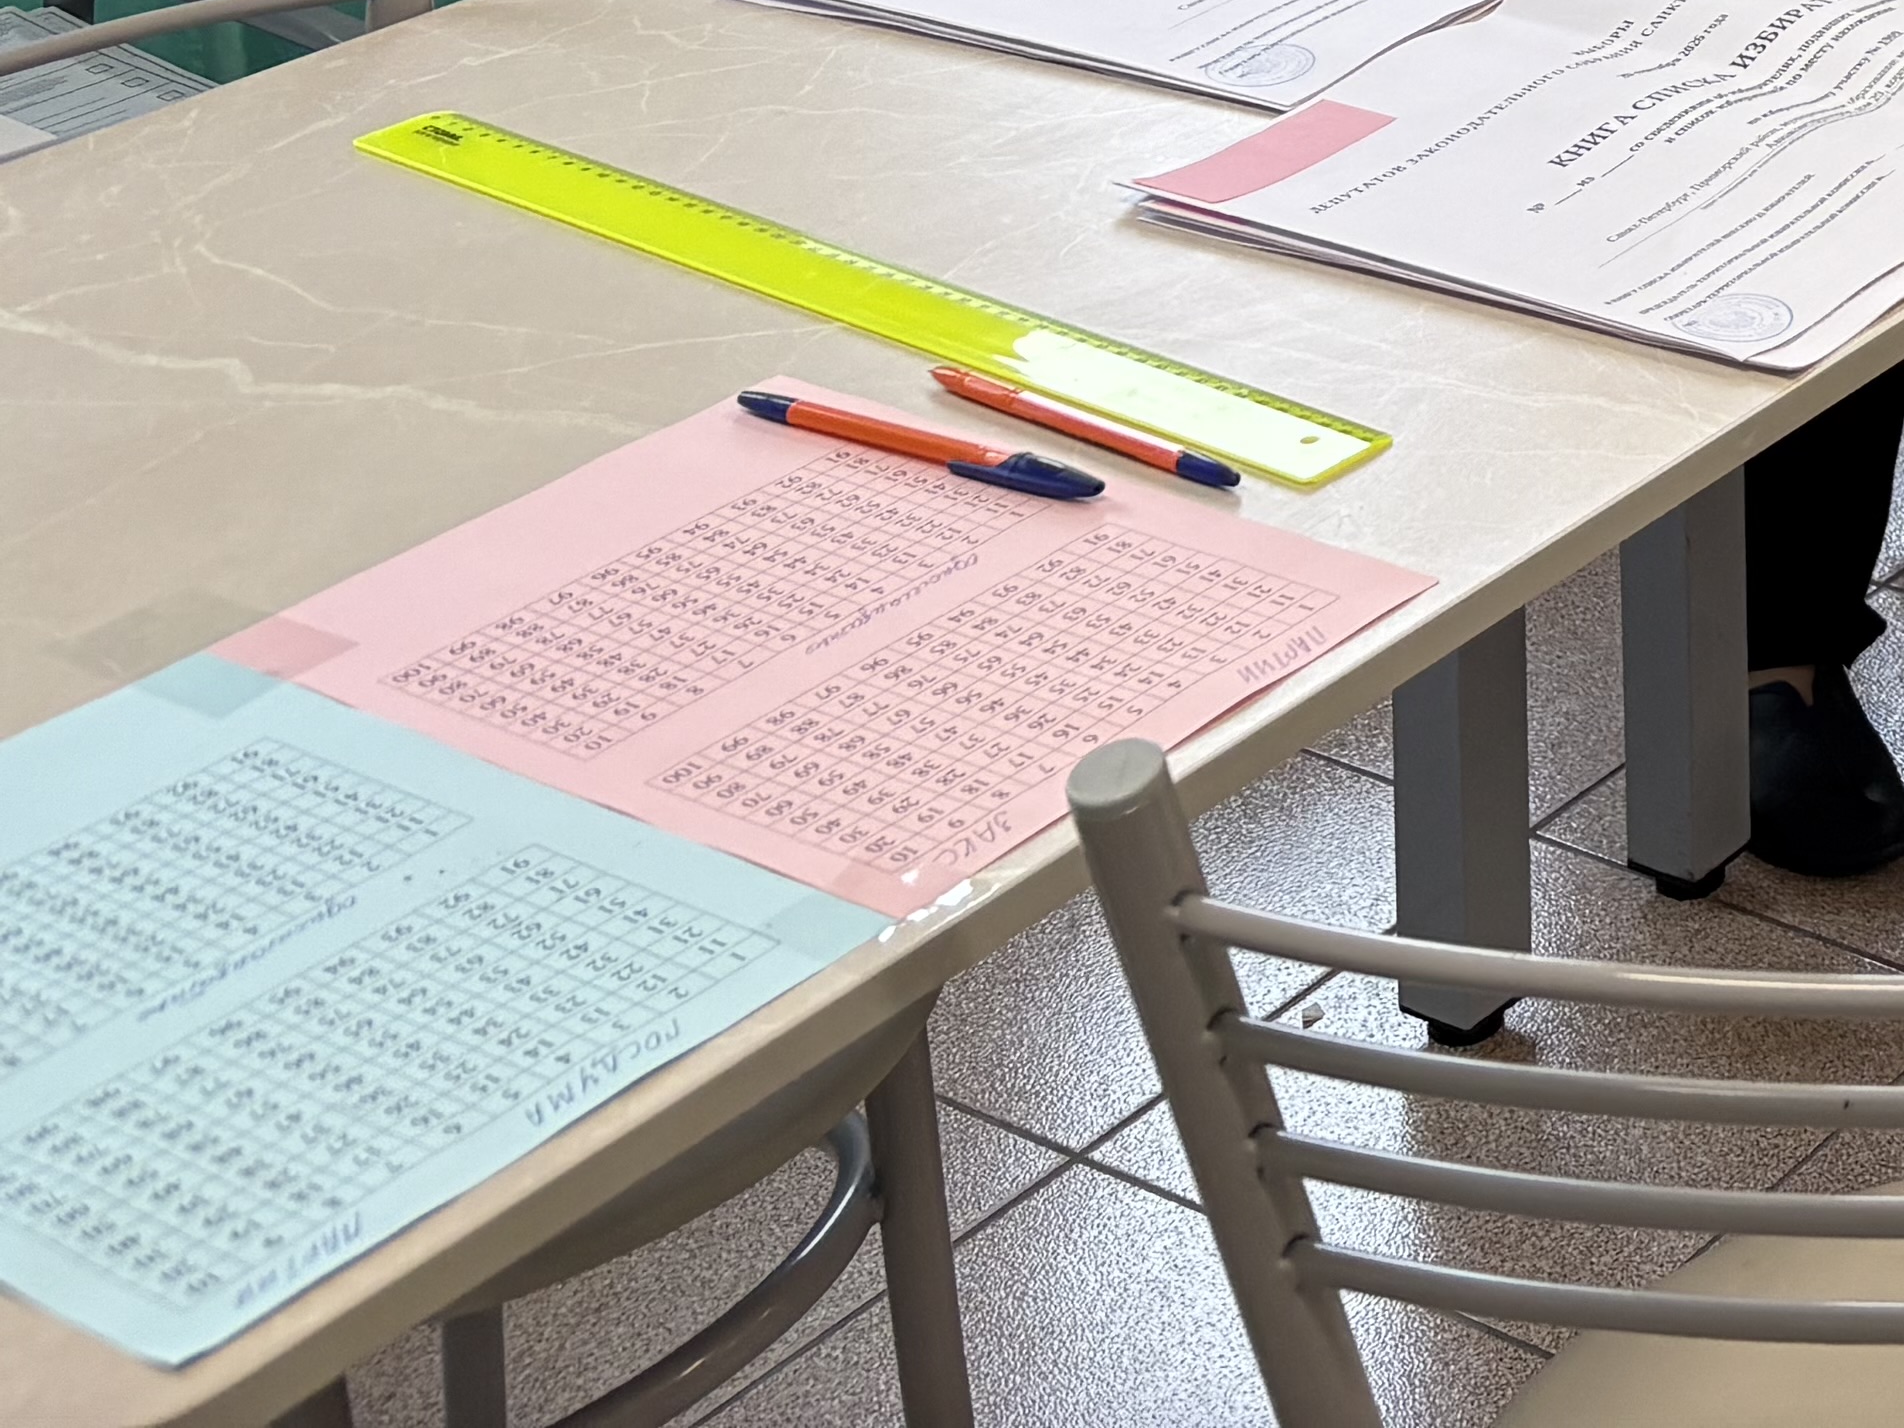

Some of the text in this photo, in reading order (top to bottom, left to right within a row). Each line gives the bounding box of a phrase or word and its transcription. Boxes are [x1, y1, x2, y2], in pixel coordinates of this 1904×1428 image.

[1547, 114, 1638, 168] КНИГА
[1631, 73, 1737, 111] СПИСКА
[662, 534, 1109, 783] 91 92 93 94 95 96 97 98 99 100
[692, 541, 1132, 789] 81 82 83 84 85 86 87 88 89 90
[716, 549, 1156, 799] 71 72 73 74 75 76 77 78 79 80
[741, 555, 1176, 808] 61 62 63 64 65 66 67 68 69 70
[765, 561, 1200, 817] 51 52 53 54 55 56 57 58 59 60
[789, 569, 1221, 825] 41 42 43 44 45 46 47 48 49 50
[814, 576, 1248, 834] 31 32 33 34 35 36 37 38 39 40
[838, 584, 1272, 843] 21 22 23 24 25 26 27 28 29 30
[864, 594, 1295, 853] 11 12 13 14 15 16 17 18 19 20
[889, 603, 1314, 862] 1 2 3 4 5 6 7 8 9 10
[932, 625, 1327, 867] ПАРТИИ ЗАКС
[525, 1017, 683, 1129] ГОСДУМА
